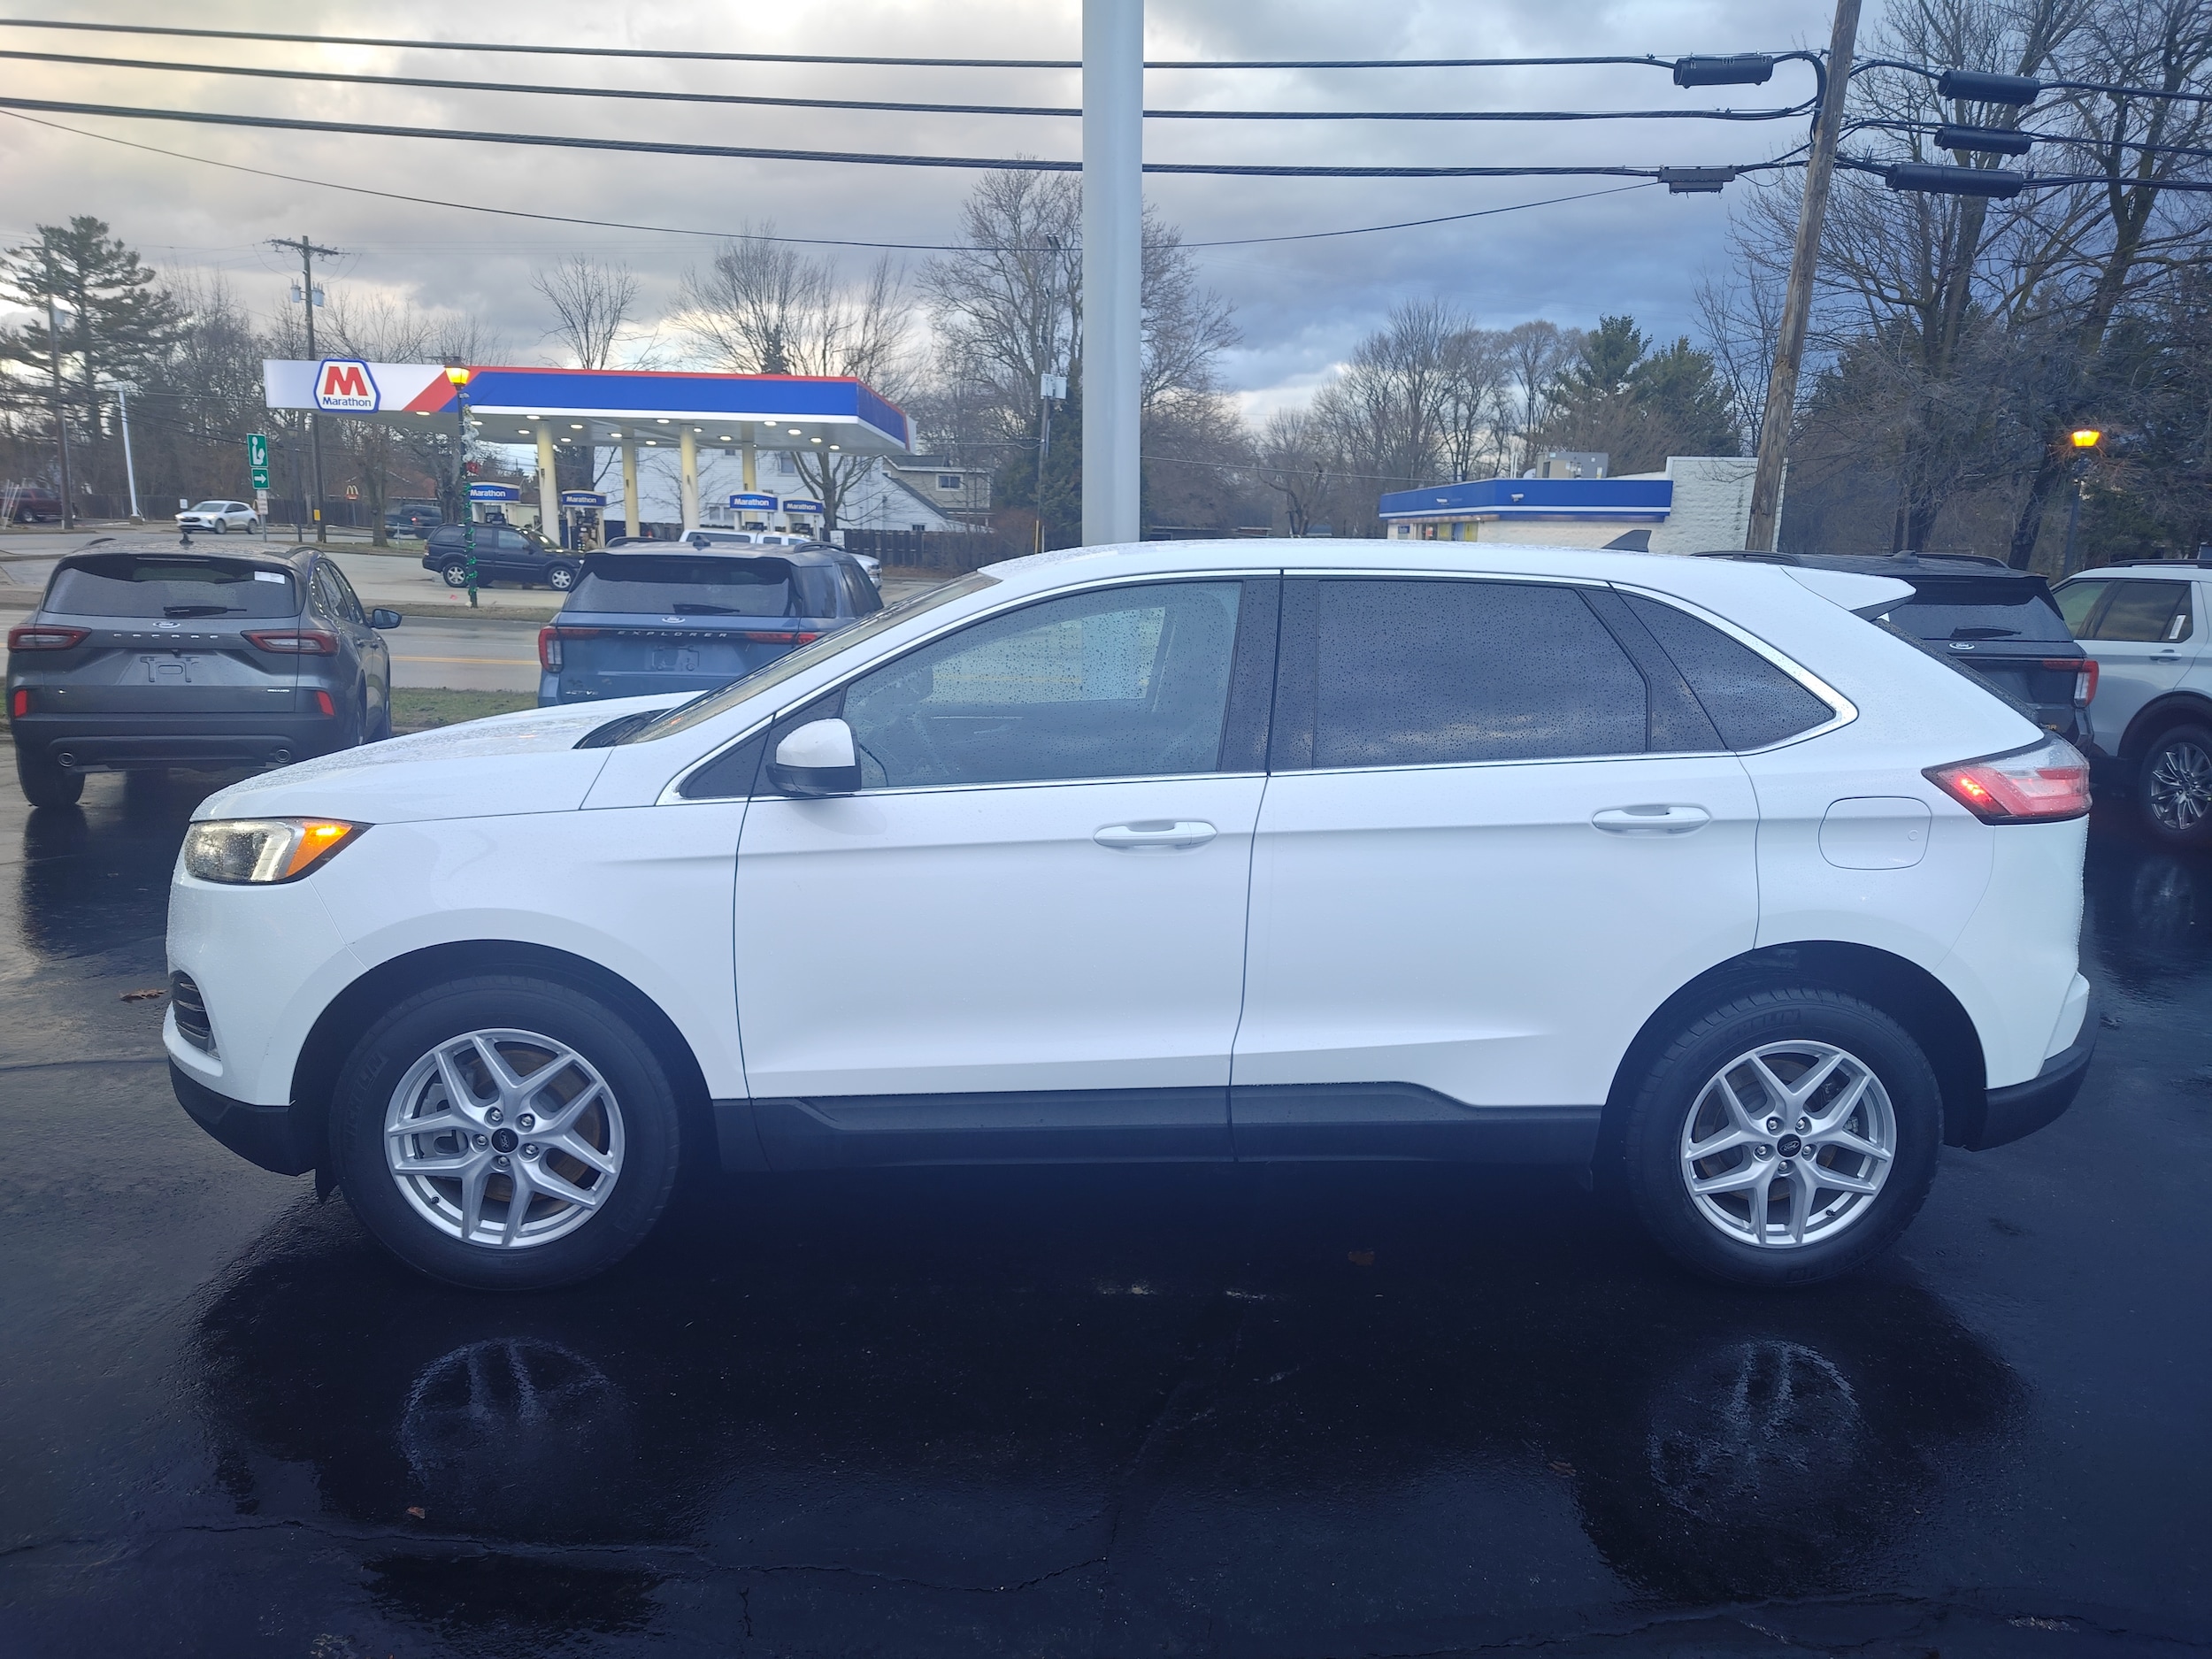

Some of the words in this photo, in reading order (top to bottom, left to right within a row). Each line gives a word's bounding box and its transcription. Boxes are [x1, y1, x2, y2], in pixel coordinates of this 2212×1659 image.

[324, 366, 368, 396] M
[322, 396, 372, 407] Marathon
[470, 488, 506, 497] Marathon
